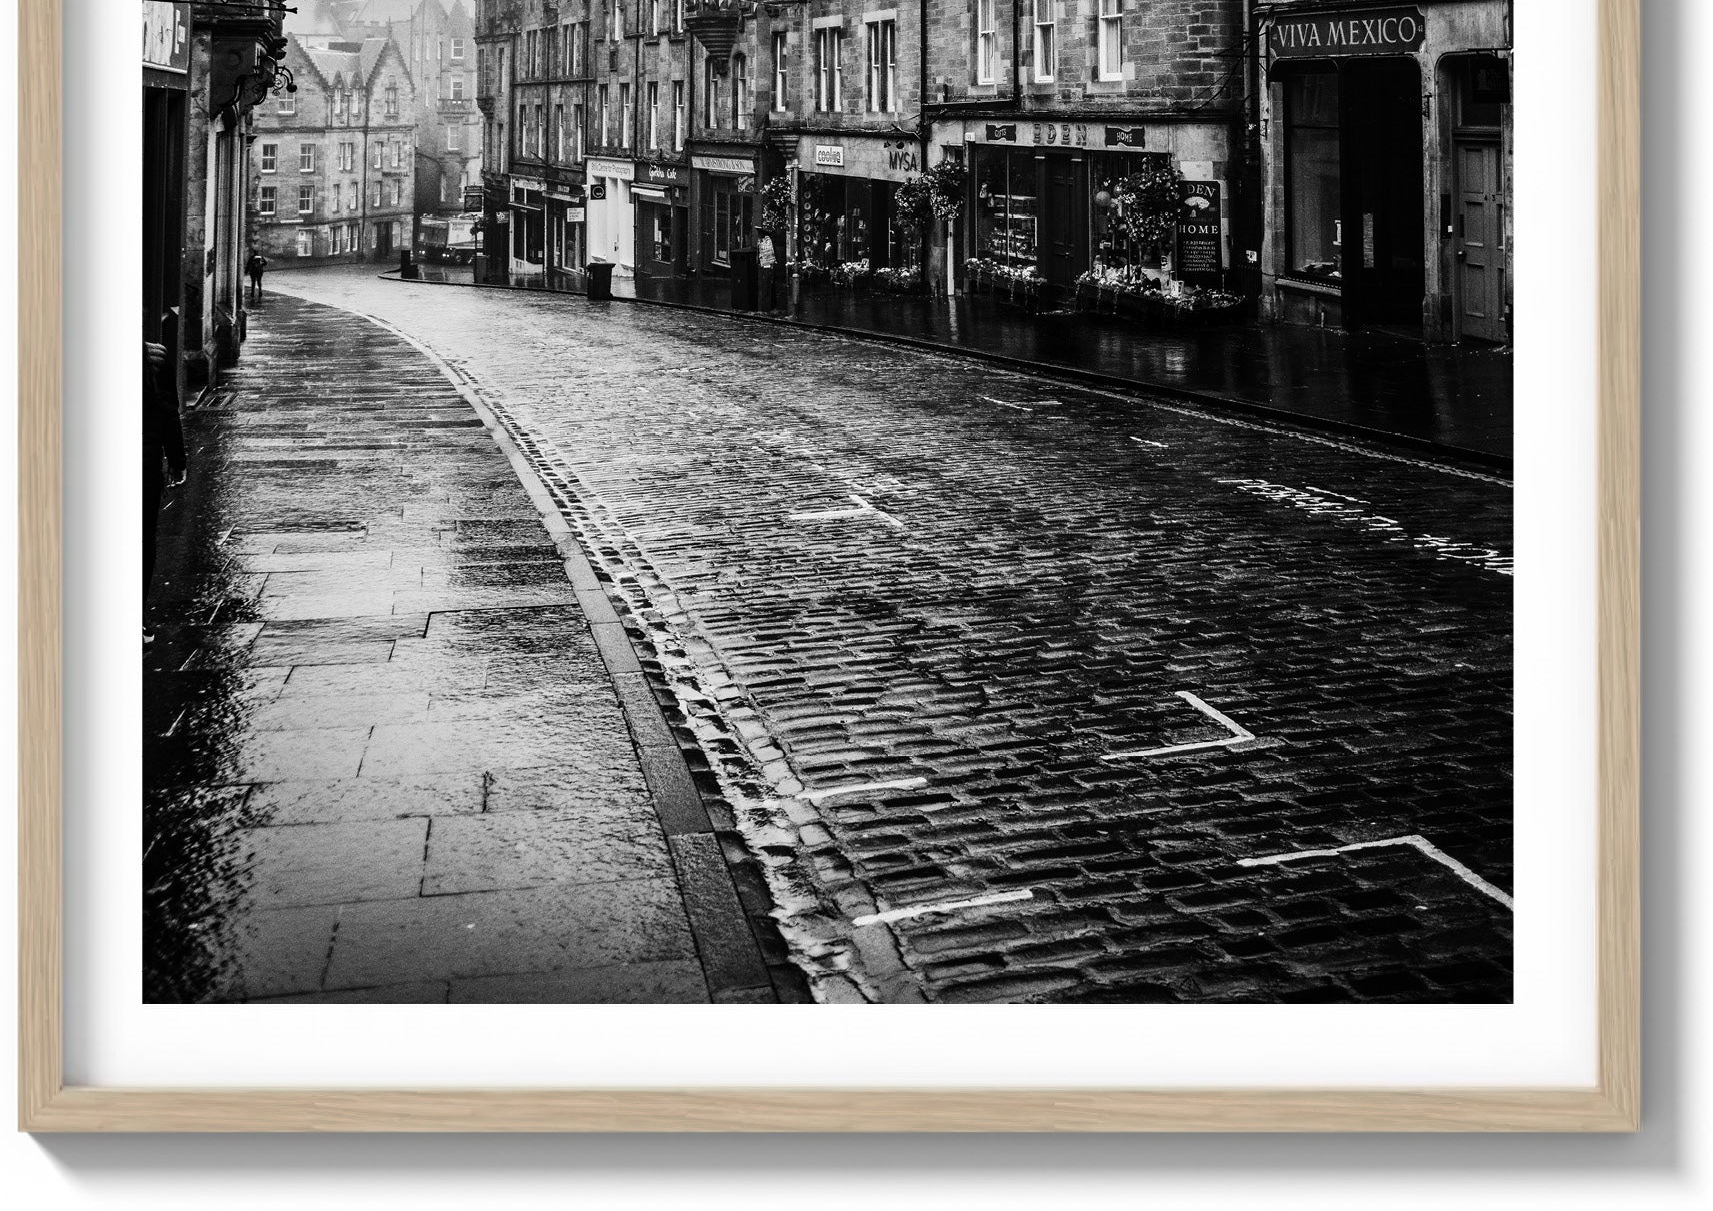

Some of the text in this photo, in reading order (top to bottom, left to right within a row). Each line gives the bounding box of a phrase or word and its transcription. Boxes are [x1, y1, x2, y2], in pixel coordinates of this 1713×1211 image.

[1277, 16, 1417, 48] VIVA MEXICO
[1033, 123, 1087, 146] EDEN
[1116, 131, 1133, 143] HOME
[889, 151, 918, 172] MYSA
[1178, 224, 1219, 235] HOME
